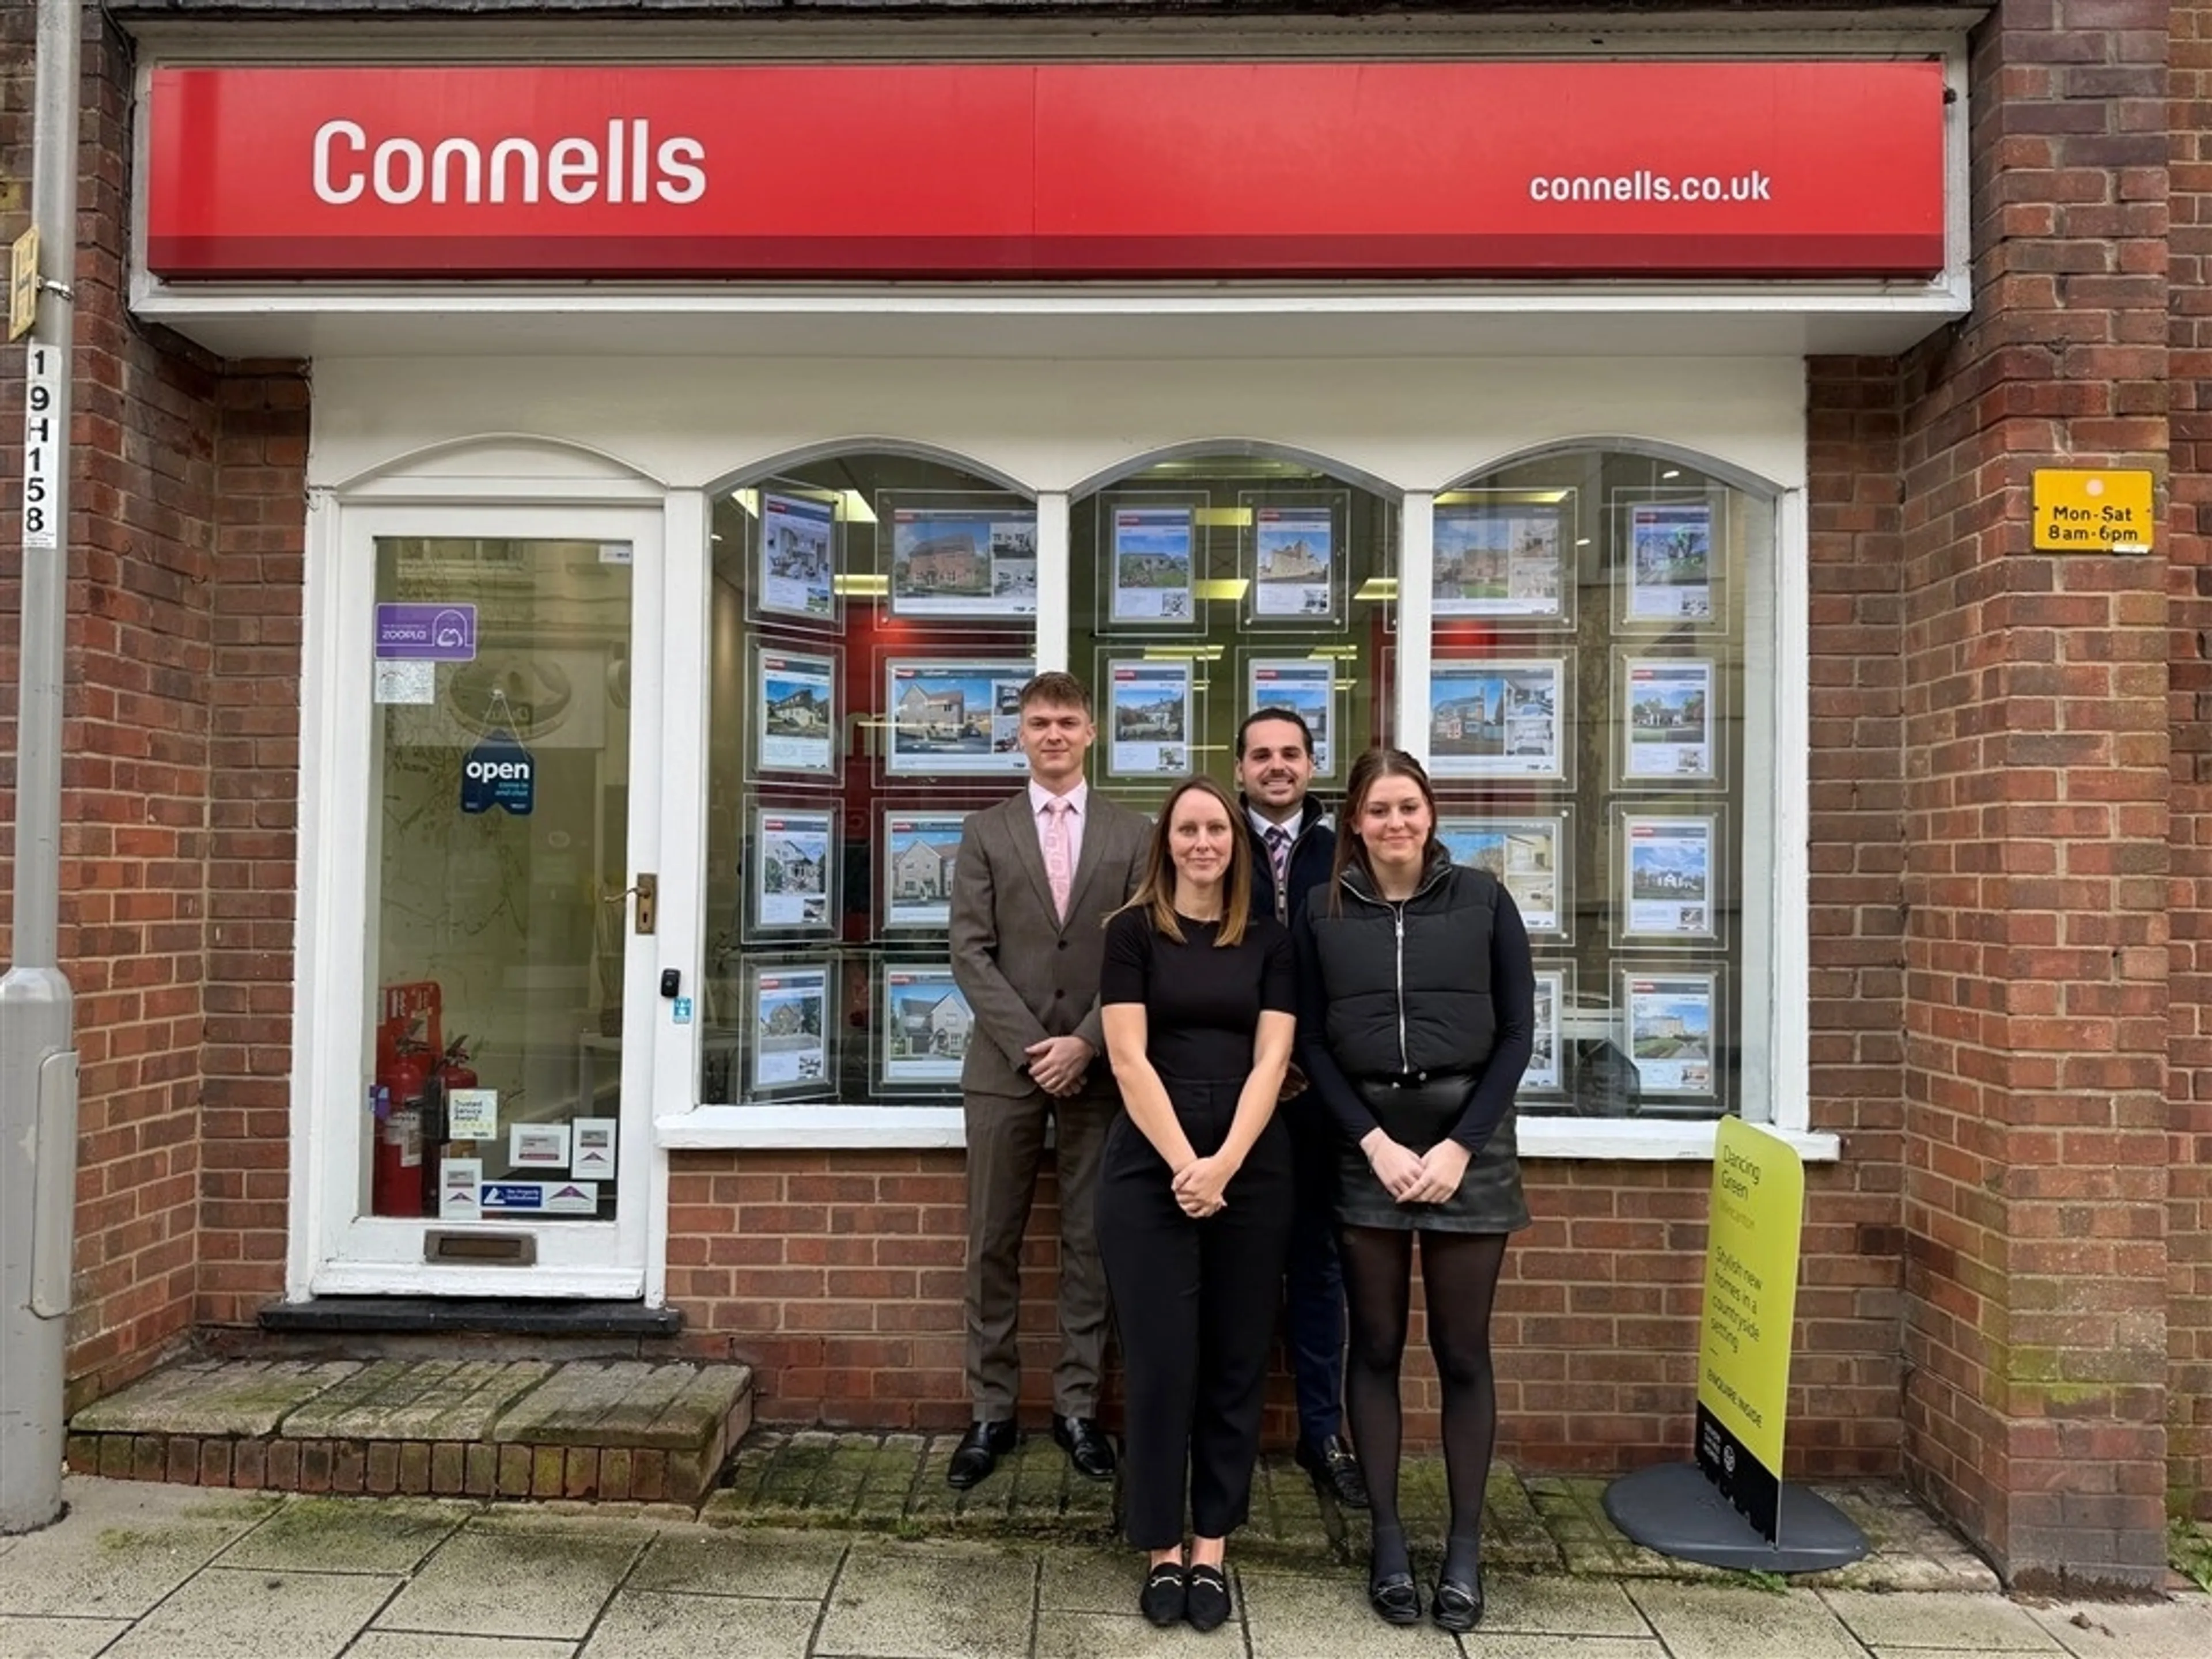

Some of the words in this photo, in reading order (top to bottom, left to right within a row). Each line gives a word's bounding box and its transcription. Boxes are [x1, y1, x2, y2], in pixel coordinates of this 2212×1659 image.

[313, 119, 707, 204] Connells
[1530, 171, 1771, 201] connells.co.uk
[466, 761, 529, 783] open
[1724, 1145, 1761, 1185] Dancing
[1721, 1169, 1748, 1202] Green
[1713, 1268, 1740, 1302] homes
[1716, 1245, 1743, 1278] Stylish
[1744, 1270, 1763, 1291] new
[1712, 1295, 1760, 1343] countryside
